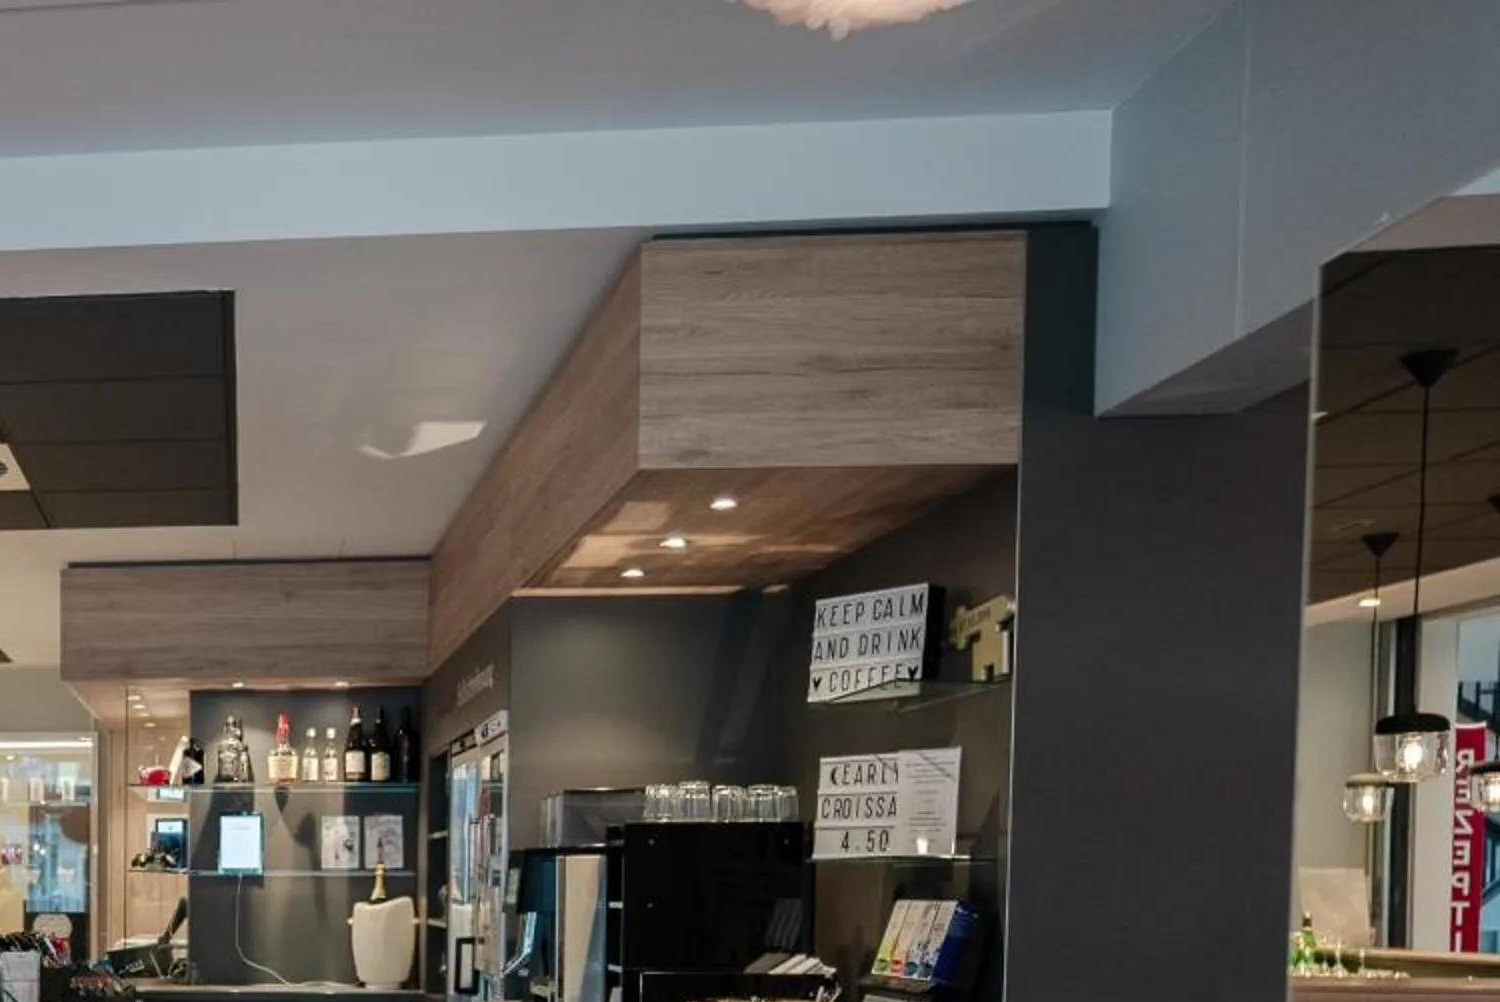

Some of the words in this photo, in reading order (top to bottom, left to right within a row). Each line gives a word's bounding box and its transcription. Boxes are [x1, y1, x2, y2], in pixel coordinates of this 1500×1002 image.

[817, 601, 865, 628] KEEP
[873, 592, 924, 620] CALM
[814, 637, 849, 660] AND
[857, 627, 921, 656] DRINK
[829, 663, 904, 692] COFFEE
[821, 796, 897, 819] CROISSA
